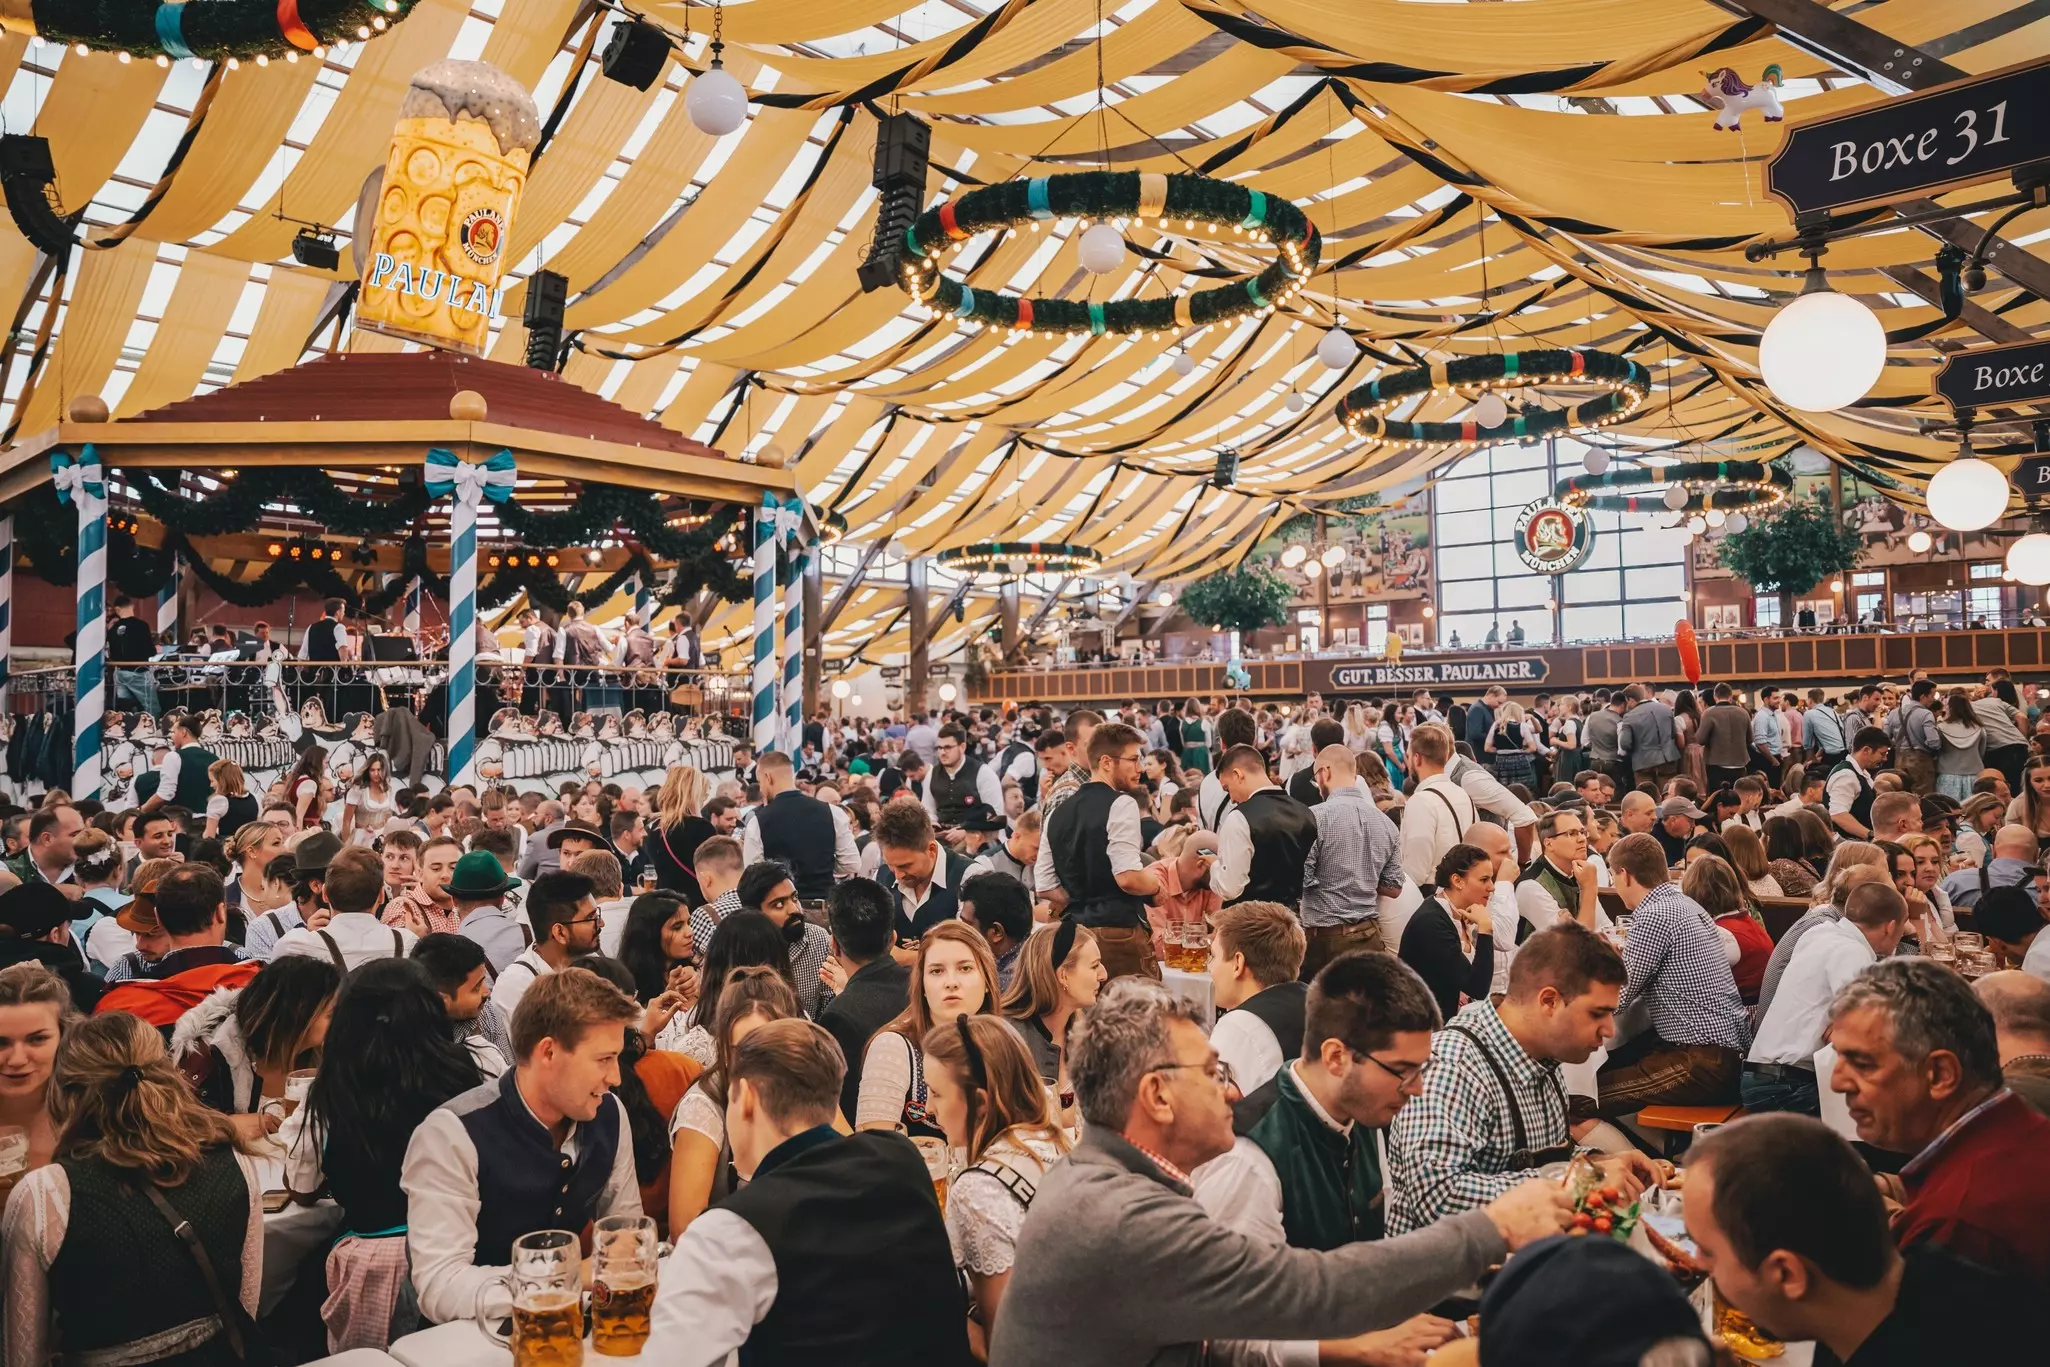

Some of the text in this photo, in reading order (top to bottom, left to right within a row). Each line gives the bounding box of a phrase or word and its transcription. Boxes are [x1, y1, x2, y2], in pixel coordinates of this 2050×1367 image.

[1828, 100, 2010, 182] Boxe 31
[1973, 363, 2044, 391] Boxe
[1338, 661, 1536, 685] GUT, BESSER, PAULANER.
